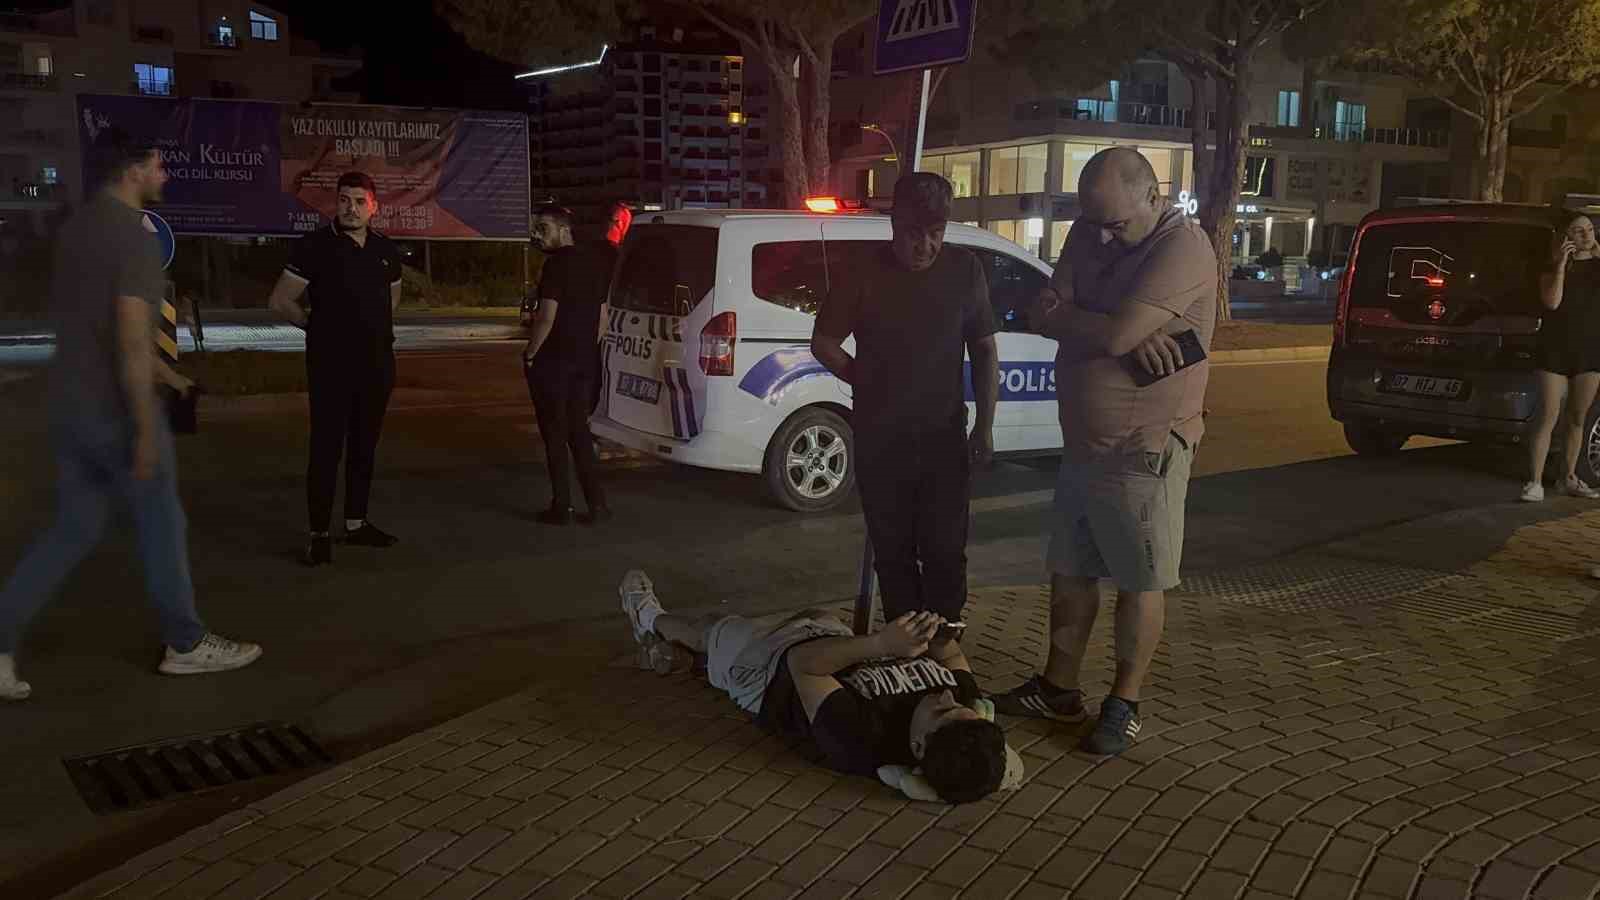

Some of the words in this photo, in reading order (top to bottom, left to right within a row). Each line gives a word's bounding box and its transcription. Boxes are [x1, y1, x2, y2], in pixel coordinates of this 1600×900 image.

[291, 118, 313, 135] YAZ
[317, 119, 355, 136] OKULU
[358, 120, 441, 140] KAYITLARIMIZ
